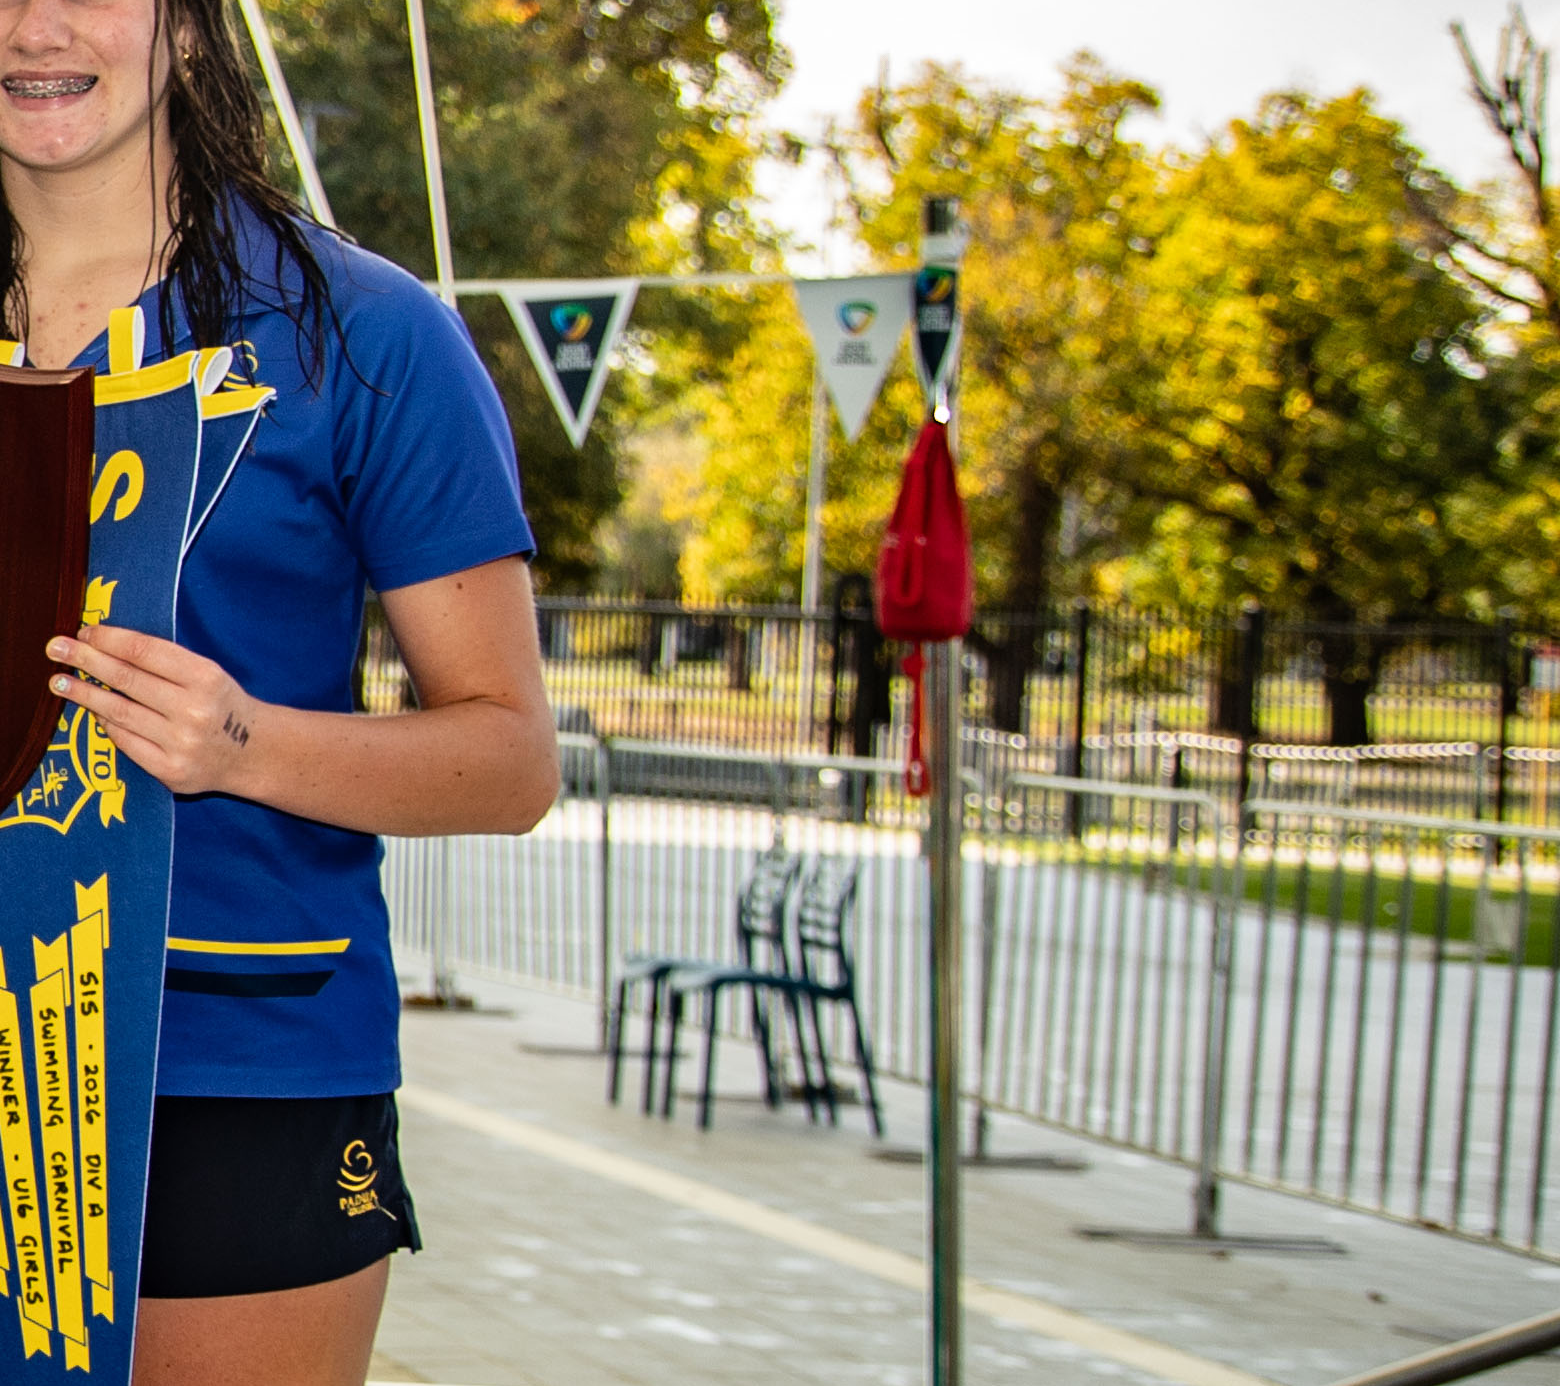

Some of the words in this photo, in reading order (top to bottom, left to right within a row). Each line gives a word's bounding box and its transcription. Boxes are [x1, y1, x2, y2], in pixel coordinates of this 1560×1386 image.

[79, 971, 99, 1016] SIS
[39, 1007, 64, 1128] SWIMMING
[84, 1064, 101, 1125] 2026
[12, 1177, 34, 1219] U16
[85, 1153, 102, 1190] DIV
[50, 1151, 74, 1275] CARNIVAL
[88, 1204, 104, 1218] A
[16, 1235, 44, 1306] GIRLS
